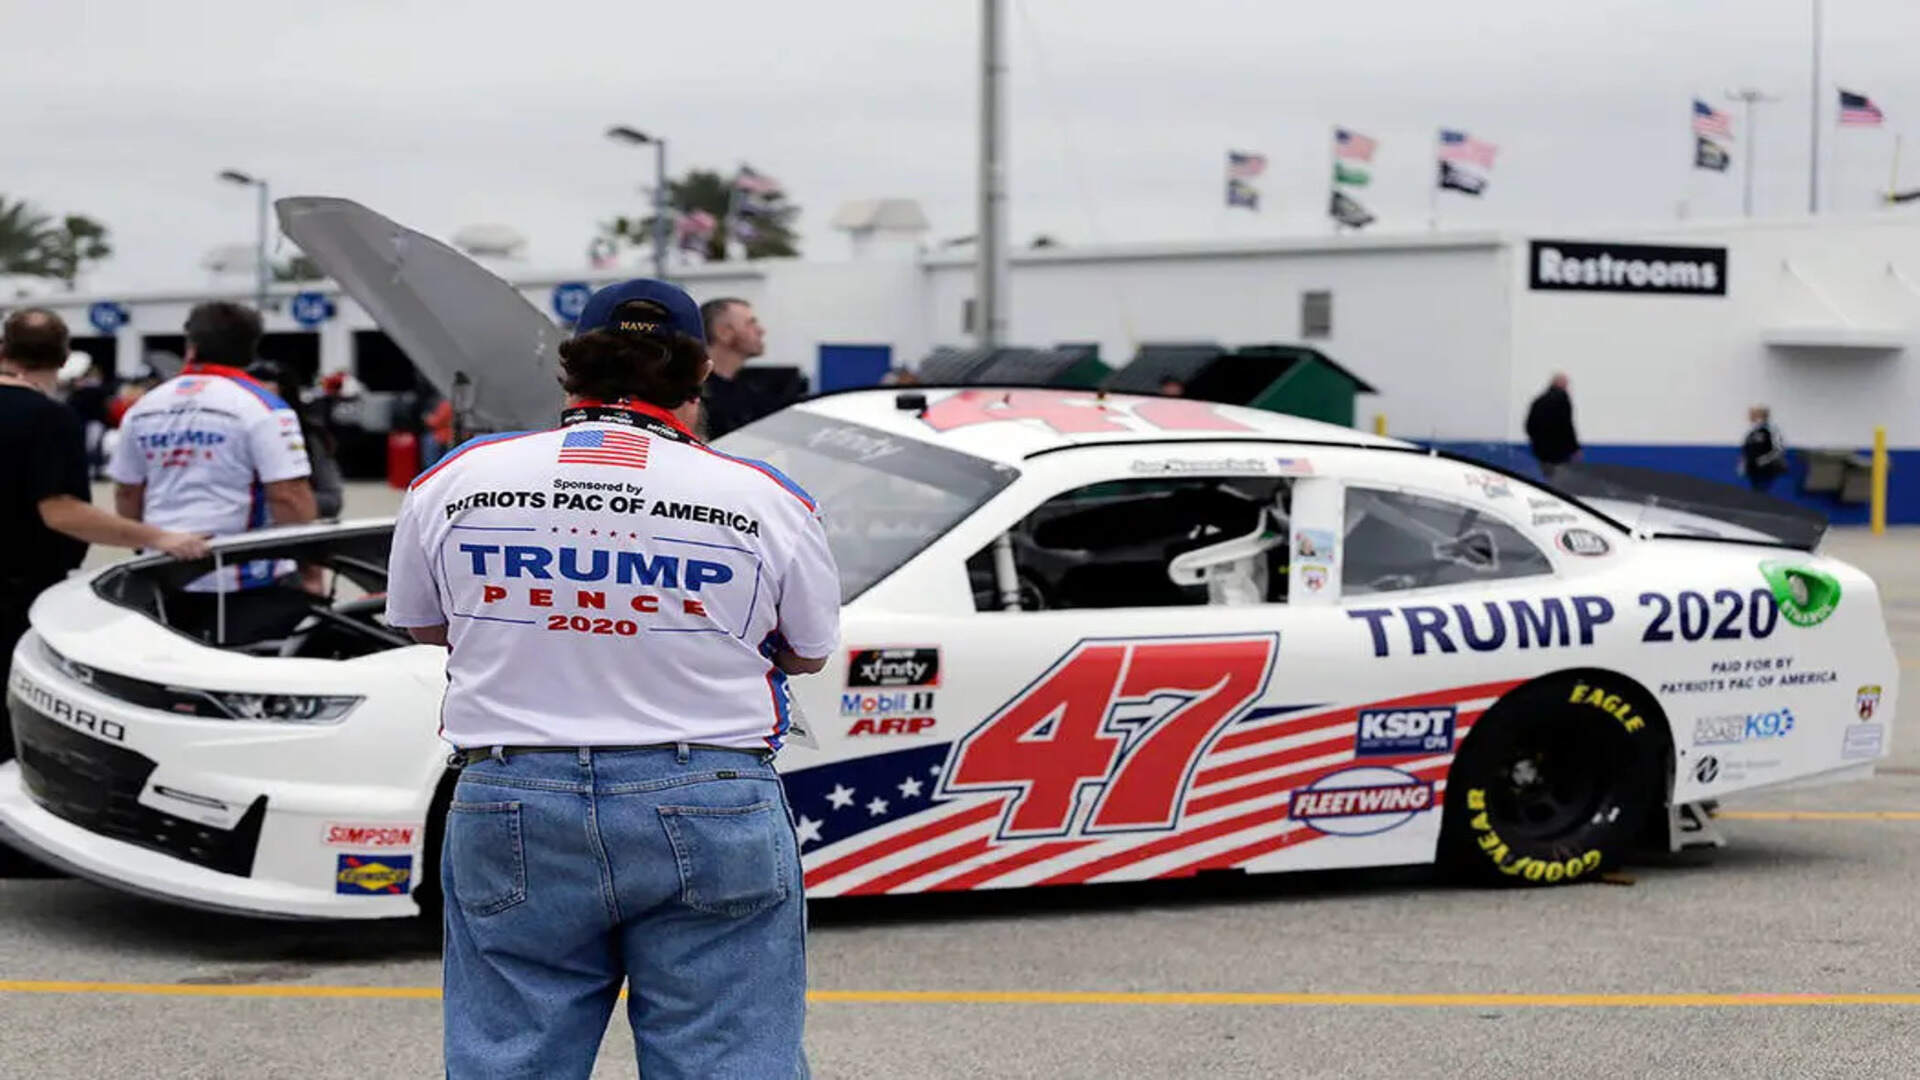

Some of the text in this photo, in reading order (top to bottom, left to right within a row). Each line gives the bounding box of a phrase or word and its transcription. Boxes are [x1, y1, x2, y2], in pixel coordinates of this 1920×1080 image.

[1538, 246, 1719, 289] Restrooms
[620, 321, 656, 332] NAVY
[553, 478, 643, 497] Sponsored by
[552, 493, 602, 513] PAC
[609, 496, 646, 515] OF
[649, 499, 761, 539] AMERICA
[459, 543, 734, 592] TRUMP
[483, 584, 708, 619] PENCE
[547, 615, 638, 637] 2020
[1346, 587, 1779, 658] TRUMP 2020
[860, 659, 929, 683] xfinity
[1711, 656, 1794, 674] PAID FOR BY
[1659, 671, 1839, 694] PATRIOTS PAC OF AMERICA
[841, 692, 907, 713] Mobil
[1568, 684, 1646, 734] EAGLE
[847, 717, 937, 736] ARP
[940, 632, 1279, 839] 47
[1361, 709, 1453, 740] KSDT
[1744, 712, 1781, 739] K9
[1293, 786, 1430, 817] FLEETWING
[327, 826, 415, 845] SIMPSON
[1466, 788, 1602, 883] GOODYEAR
